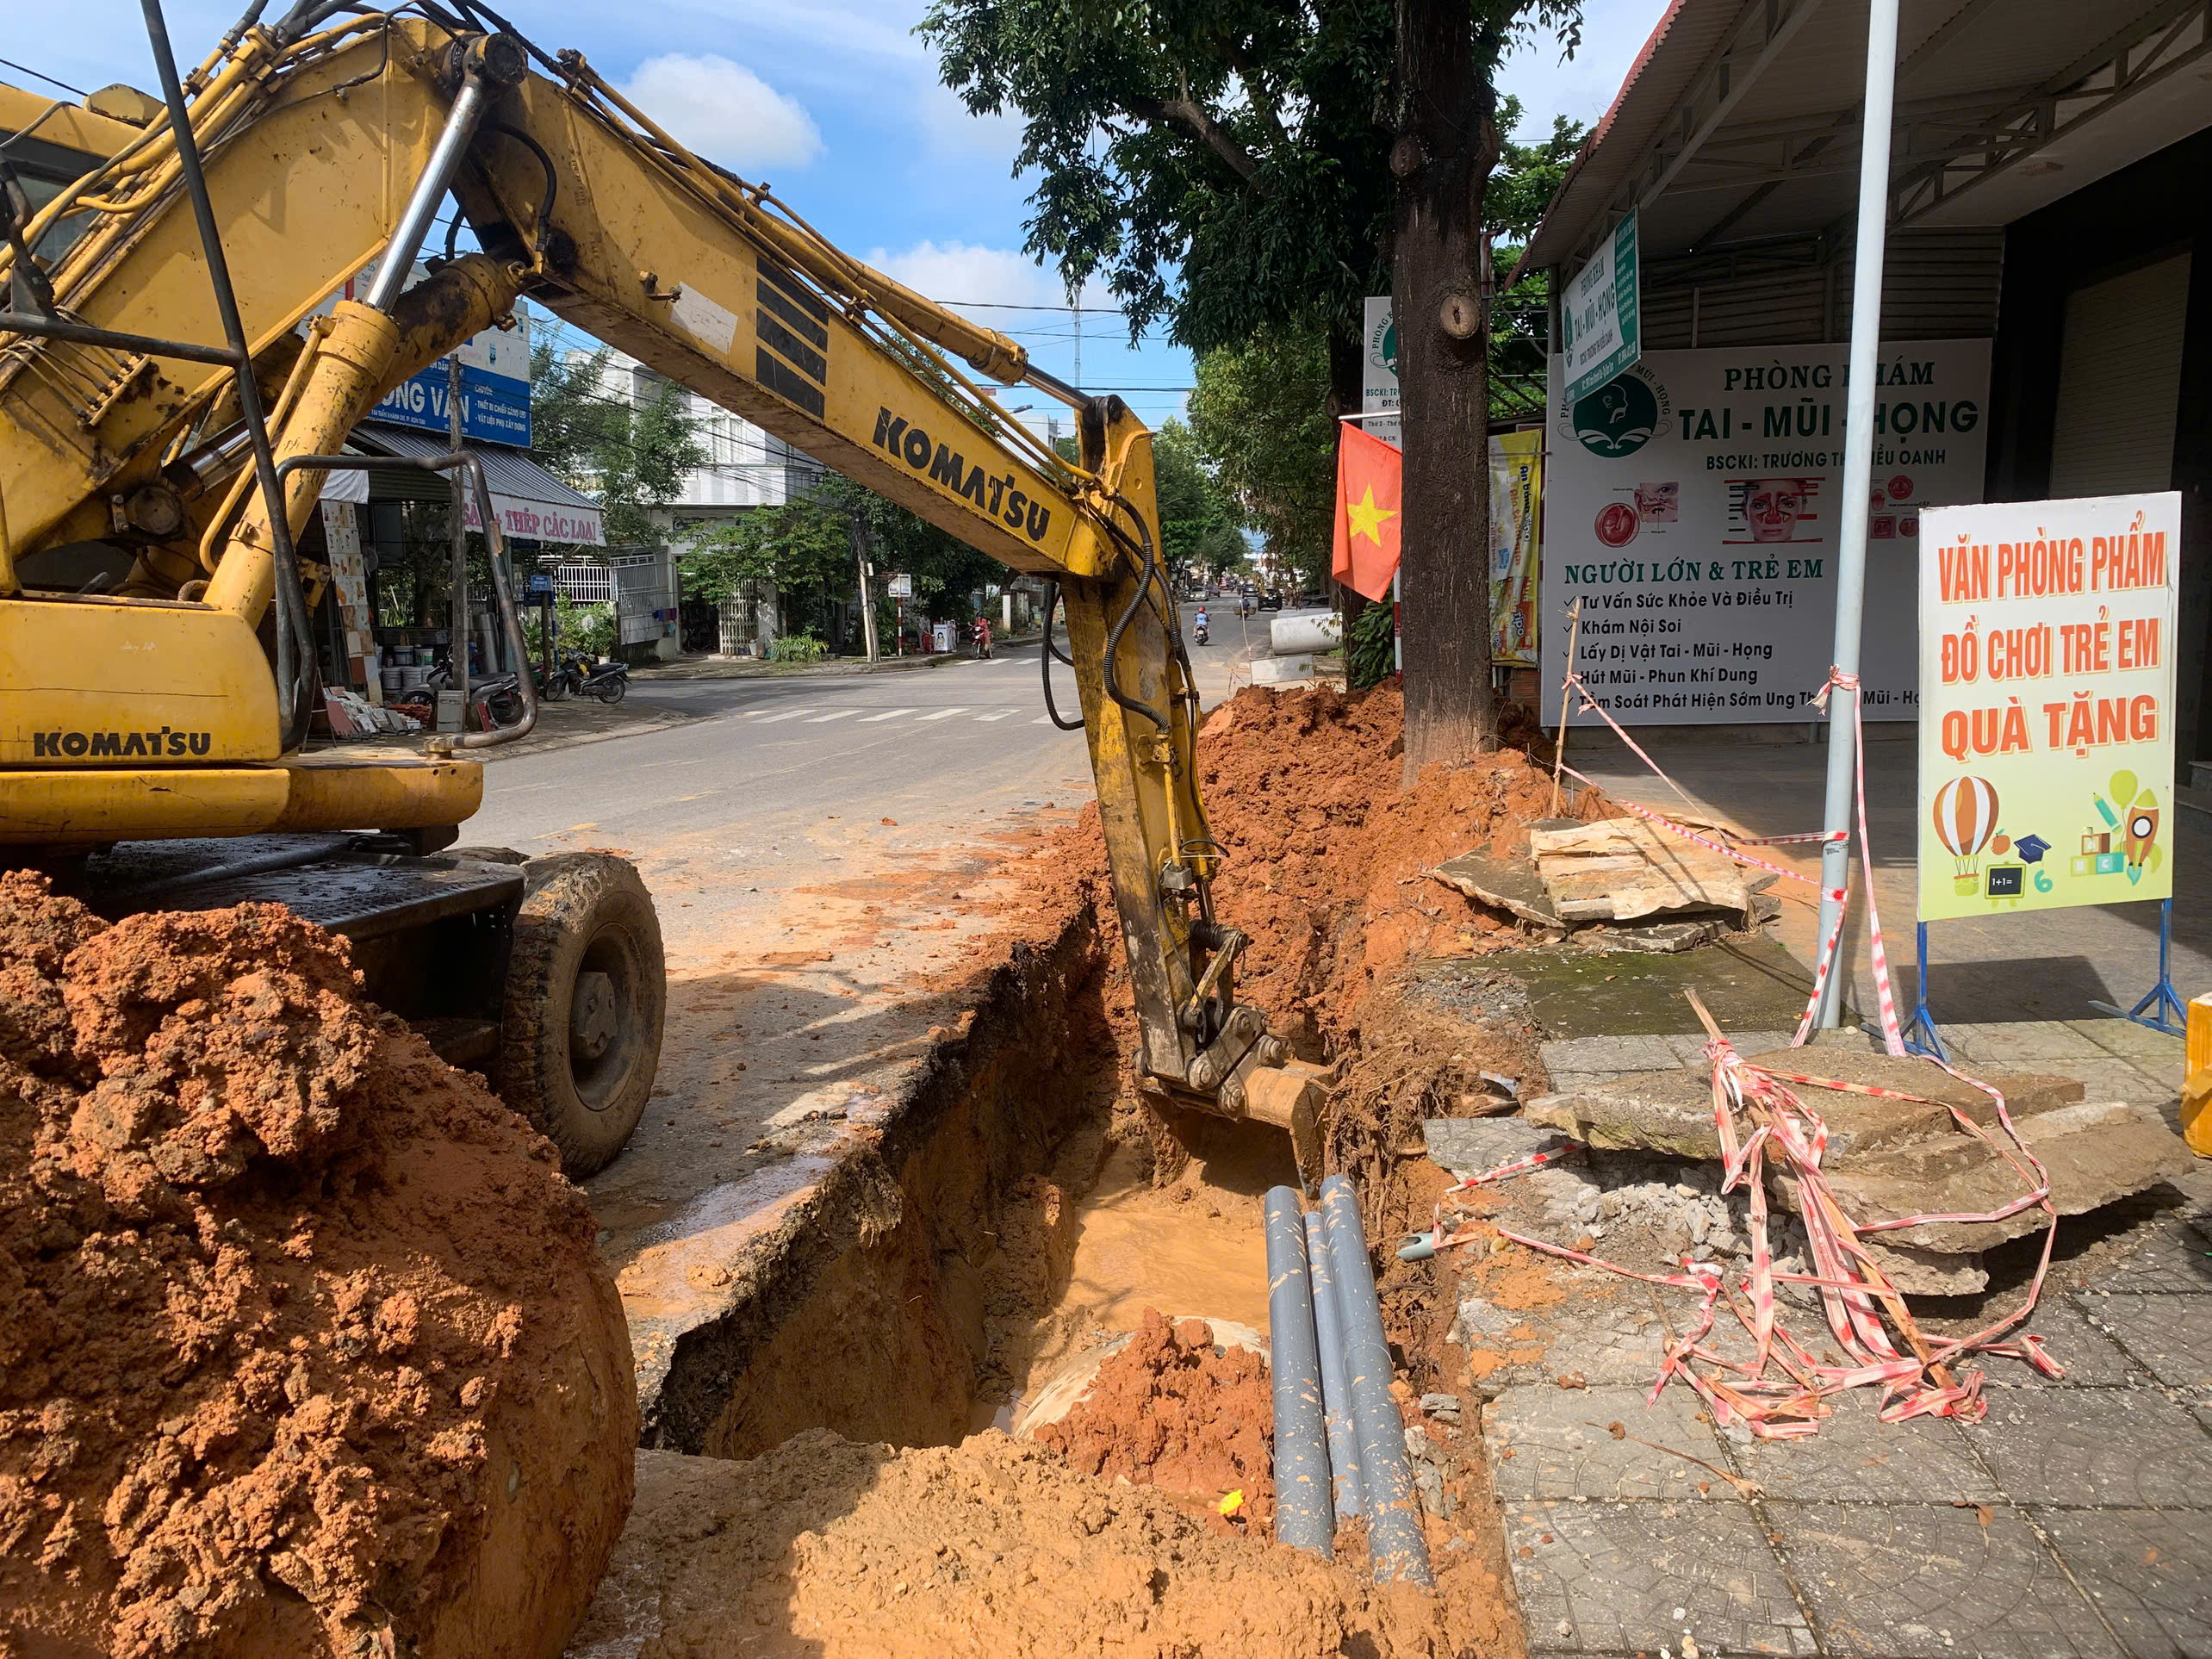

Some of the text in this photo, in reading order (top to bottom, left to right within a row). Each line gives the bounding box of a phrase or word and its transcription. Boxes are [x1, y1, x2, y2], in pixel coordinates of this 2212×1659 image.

[1599, 282, 1615, 326] HỌNG
[1372, 318, 1389, 349] PHÒNG
[1724, 359, 1832, 391] PHÒNG
[1656, 384, 1671, 415] HỌNG
[1679, 407, 1730, 440] TAI
[1764, 397, 1830, 438] MŨI
[873, 406, 1050, 542] KOMATSU
[1706, 454, 1758, 470] BSCKI:
[1762, 450, 1828, 469] TRƯƠNG
[1899, 449, 1946, 465] OANH
[544, 511, 569, 538] CÁC
[1564, 553, 1824, 584] NGƯỜI LỚN & TRẺ EM
[1938, 510, 2168, 604] VĂN PHÒNG PHẨM
[1581, 587, 1793, 609] Tư Vấn Sức Khỏe Và Điều Trị
[1513, 609, 1525, 637] Tipo
[1581, 618, 1681, 637] Khám Nội Soi
[1581, 643, 1606, 662] Lấy
[1610, 644, 1625, 662] Dị
[1630, 644, 1656, 662] Vật
[1659, 644, 1681, 658] Tai
[1693, 643, 1720, 657] Mũi
[1732, 643, 1773, 660] Họng
[1941, 605, 2161, 685] ĐỒ CHƠI TRẺ EM
[1580, 669, 1606, 684] Hút
[1610, 669, 1637, 684] Mũi
[1649, 668, 1686, 683] Phun
[1690, 667, 1715, 682] Khí
[1718, 668, 1758, 686] Dung
[1614, 693, 1649, 708] Soát
[1653, 693, 1687, 708] Phát
[1691, 693, 1725, 711] Hiện
[1730, 691, 1762, 706] Sớm
[1767, 693, 1795, 709] Ung
[1863, 690, 1890, 704] Mũi
[1942, 689, 2159, 763] QUÀ TẶNG
[34, 726, 211, 756] KOMATSU
[1991, 877, 2013, 886] 1+1=
[2034, 869, 2054, 893] 6
